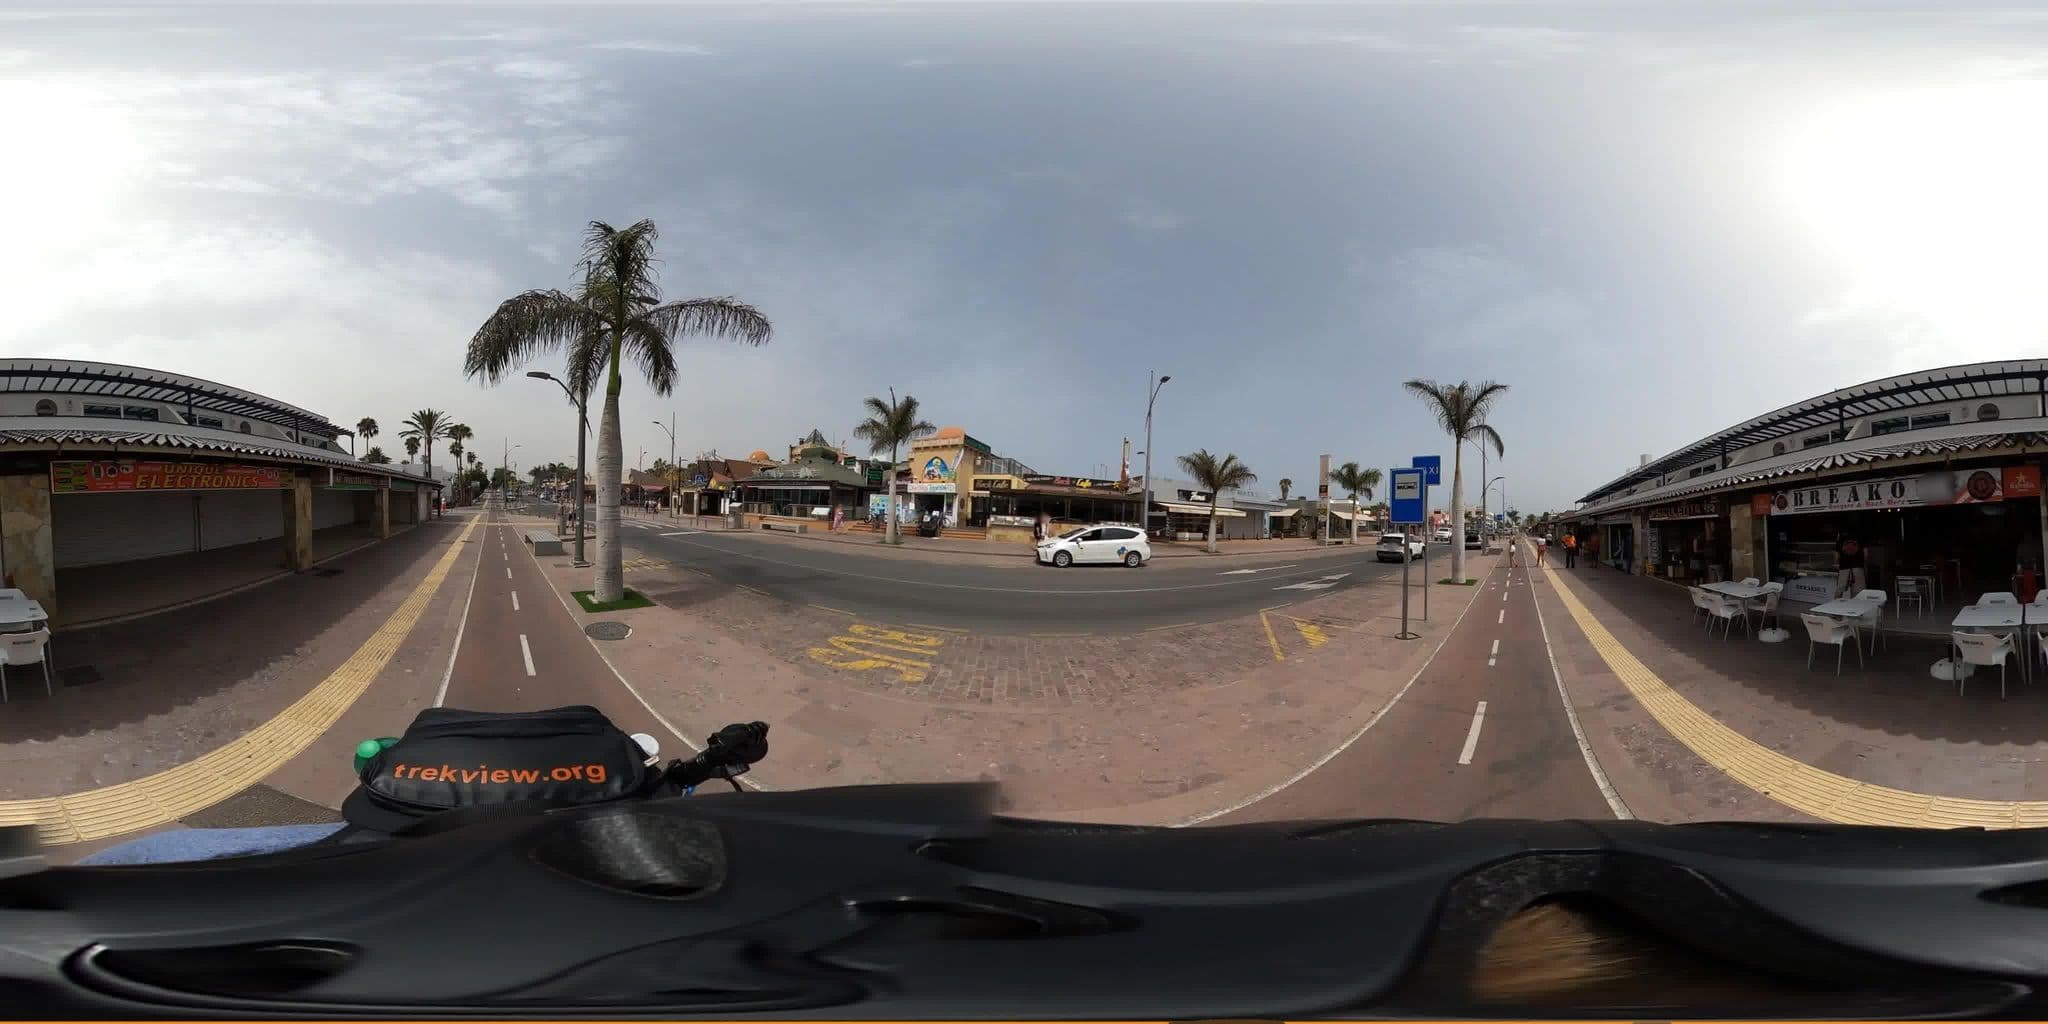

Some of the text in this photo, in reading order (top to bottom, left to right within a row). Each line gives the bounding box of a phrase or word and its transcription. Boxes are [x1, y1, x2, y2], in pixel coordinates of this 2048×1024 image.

[164, 464, 222, 475] UNIQUE
[136, 474, 260, 488] ELECTRONICS
[1793, 481, 1905, 506] BREAKO
[807, 624, 944, 682] BUS
[393, 763, 607, 784] trekview.org
